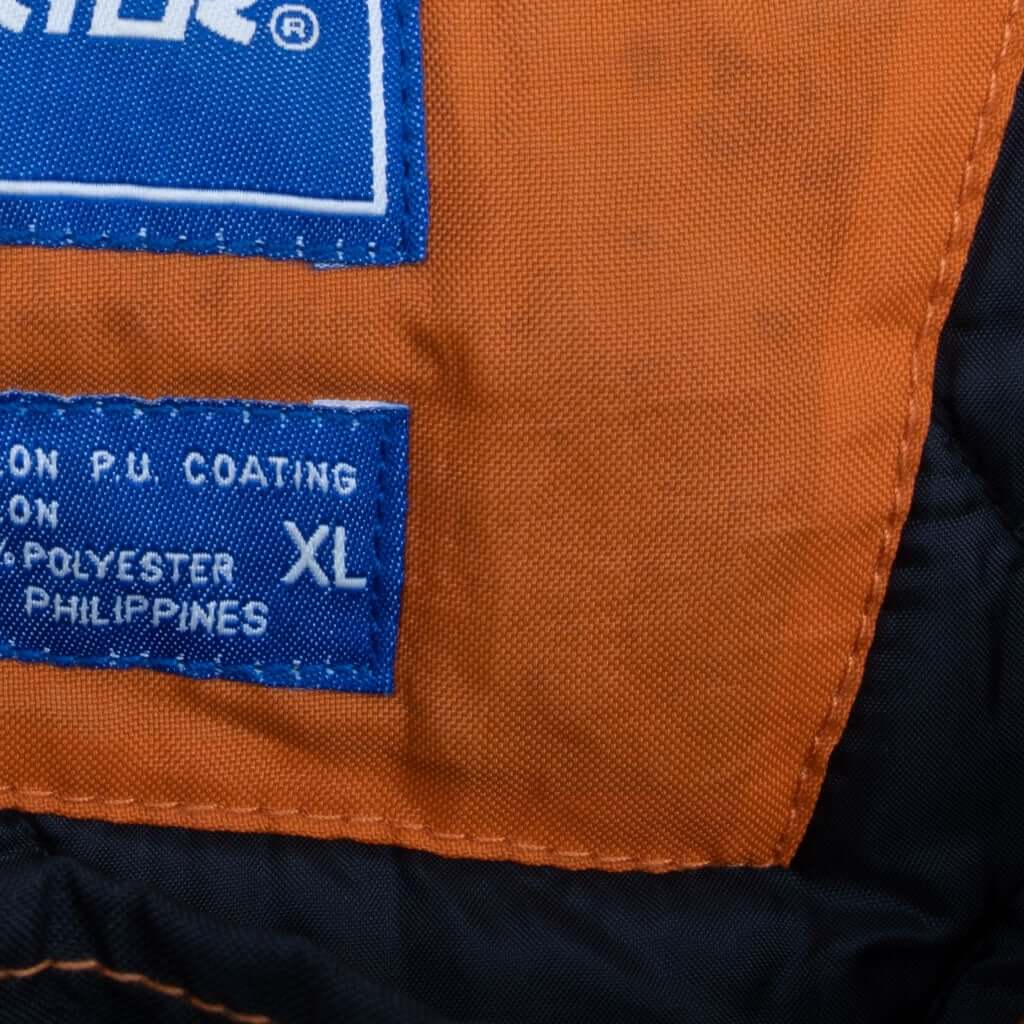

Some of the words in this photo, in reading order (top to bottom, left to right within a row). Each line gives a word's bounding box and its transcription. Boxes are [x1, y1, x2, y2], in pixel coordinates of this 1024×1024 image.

[183, 452, 357, 495] COATING
[23, 541, 234, 585] POLYESTER
[280, 520, 367, 589] XL
[24, 587, 269, 636] PHILIPPINES
